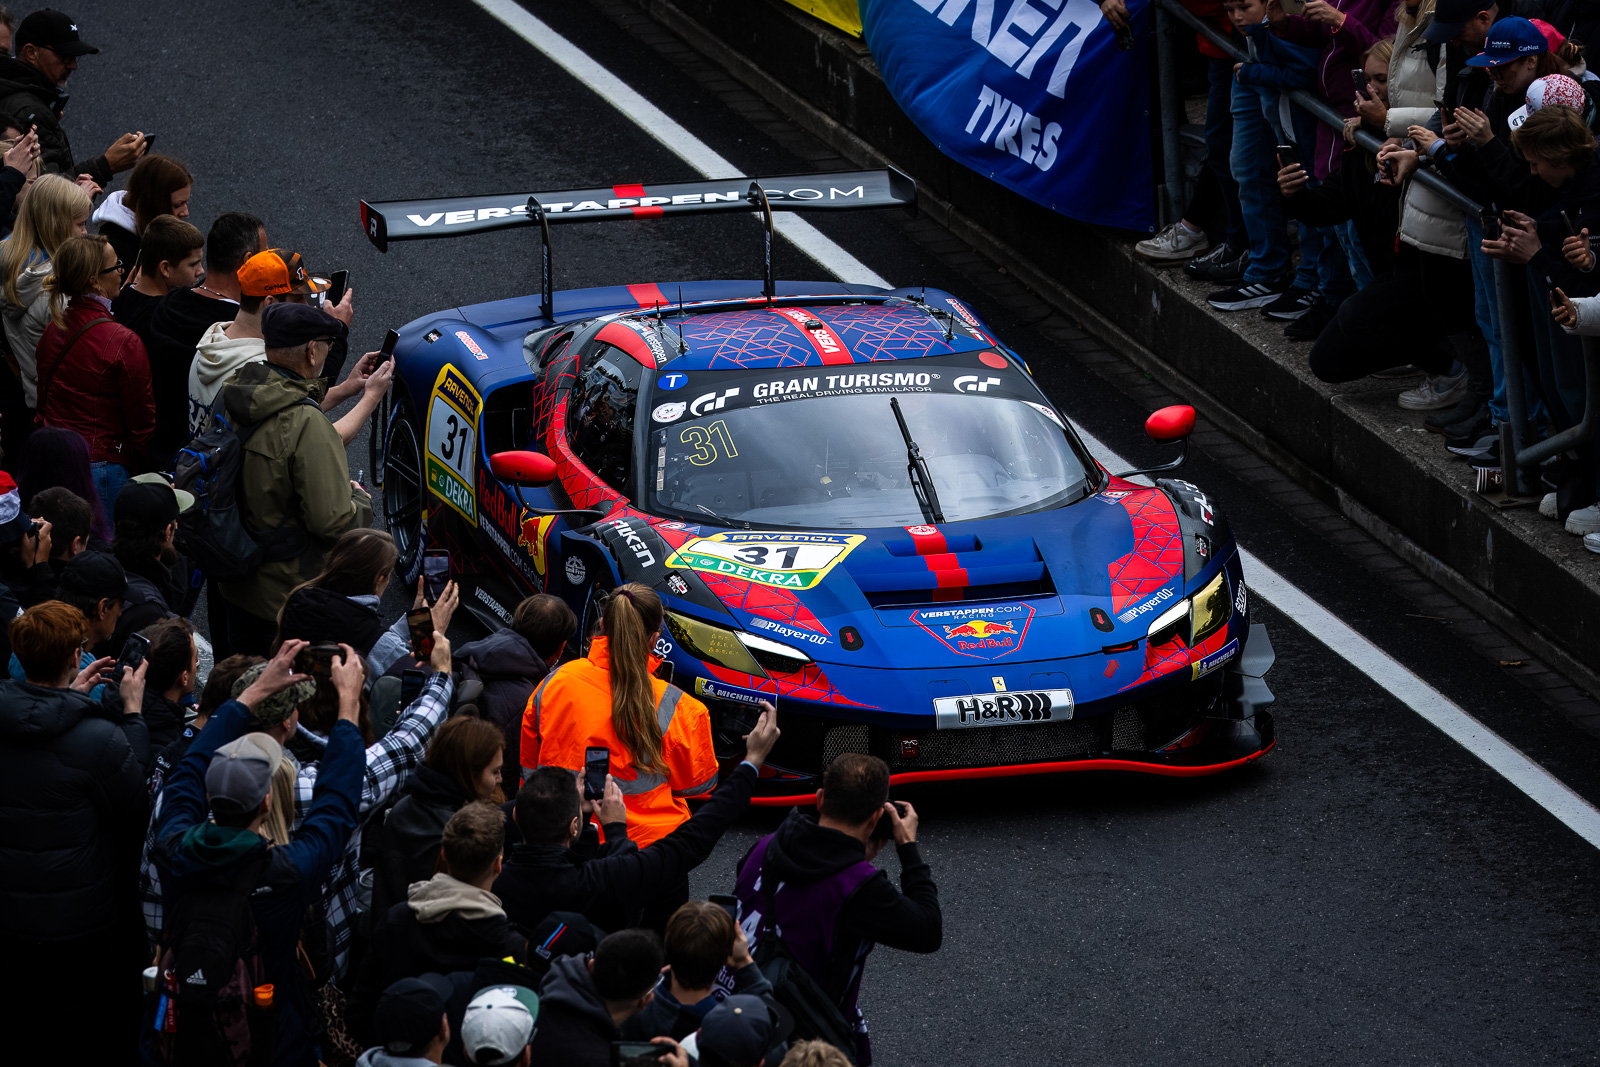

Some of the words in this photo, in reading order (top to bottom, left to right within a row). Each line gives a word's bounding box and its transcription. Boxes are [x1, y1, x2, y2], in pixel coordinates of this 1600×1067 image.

[912, 0, 1104, 99] EN
[965, 84, 1063, 172] TYRES
[406, 185, 864, 227] VERSTAPPENCOM
[296, 267, 304, 280] 1
[665, 374, 683, 388] T
[753, 377, 819, 399] GRAN
[443, 377, 476, 415] RAVENOL
[757, 396, 781, 405] THE
[785, 393, 814, 402] REAL
[815, 387, 863, 397] DRIVING
[865, 386, 933, 394] SIMULATOR
[441, 415, 468, 472] 31
[680, 419, 738, 466] 31
[446, 475, 475, 519] DEKRA
[479, 468, 498, 520] Red
[497, 491, 518, 542] Bull
[732, 533, 840, 543] RAVENOL
[733, 545, 803, 569] 31
[716, 560, 803, 587] DEKRA
[920, 606, 1022, 619] VERSTAPPEN.COM
[1130, 595, 1162, 618] Player
[765, 621, 809, 641] Player
[958, 639, 986, 651] Red
[986, 637, 1013, 648] Bull
[957, 695, 1017, 723] H&R
